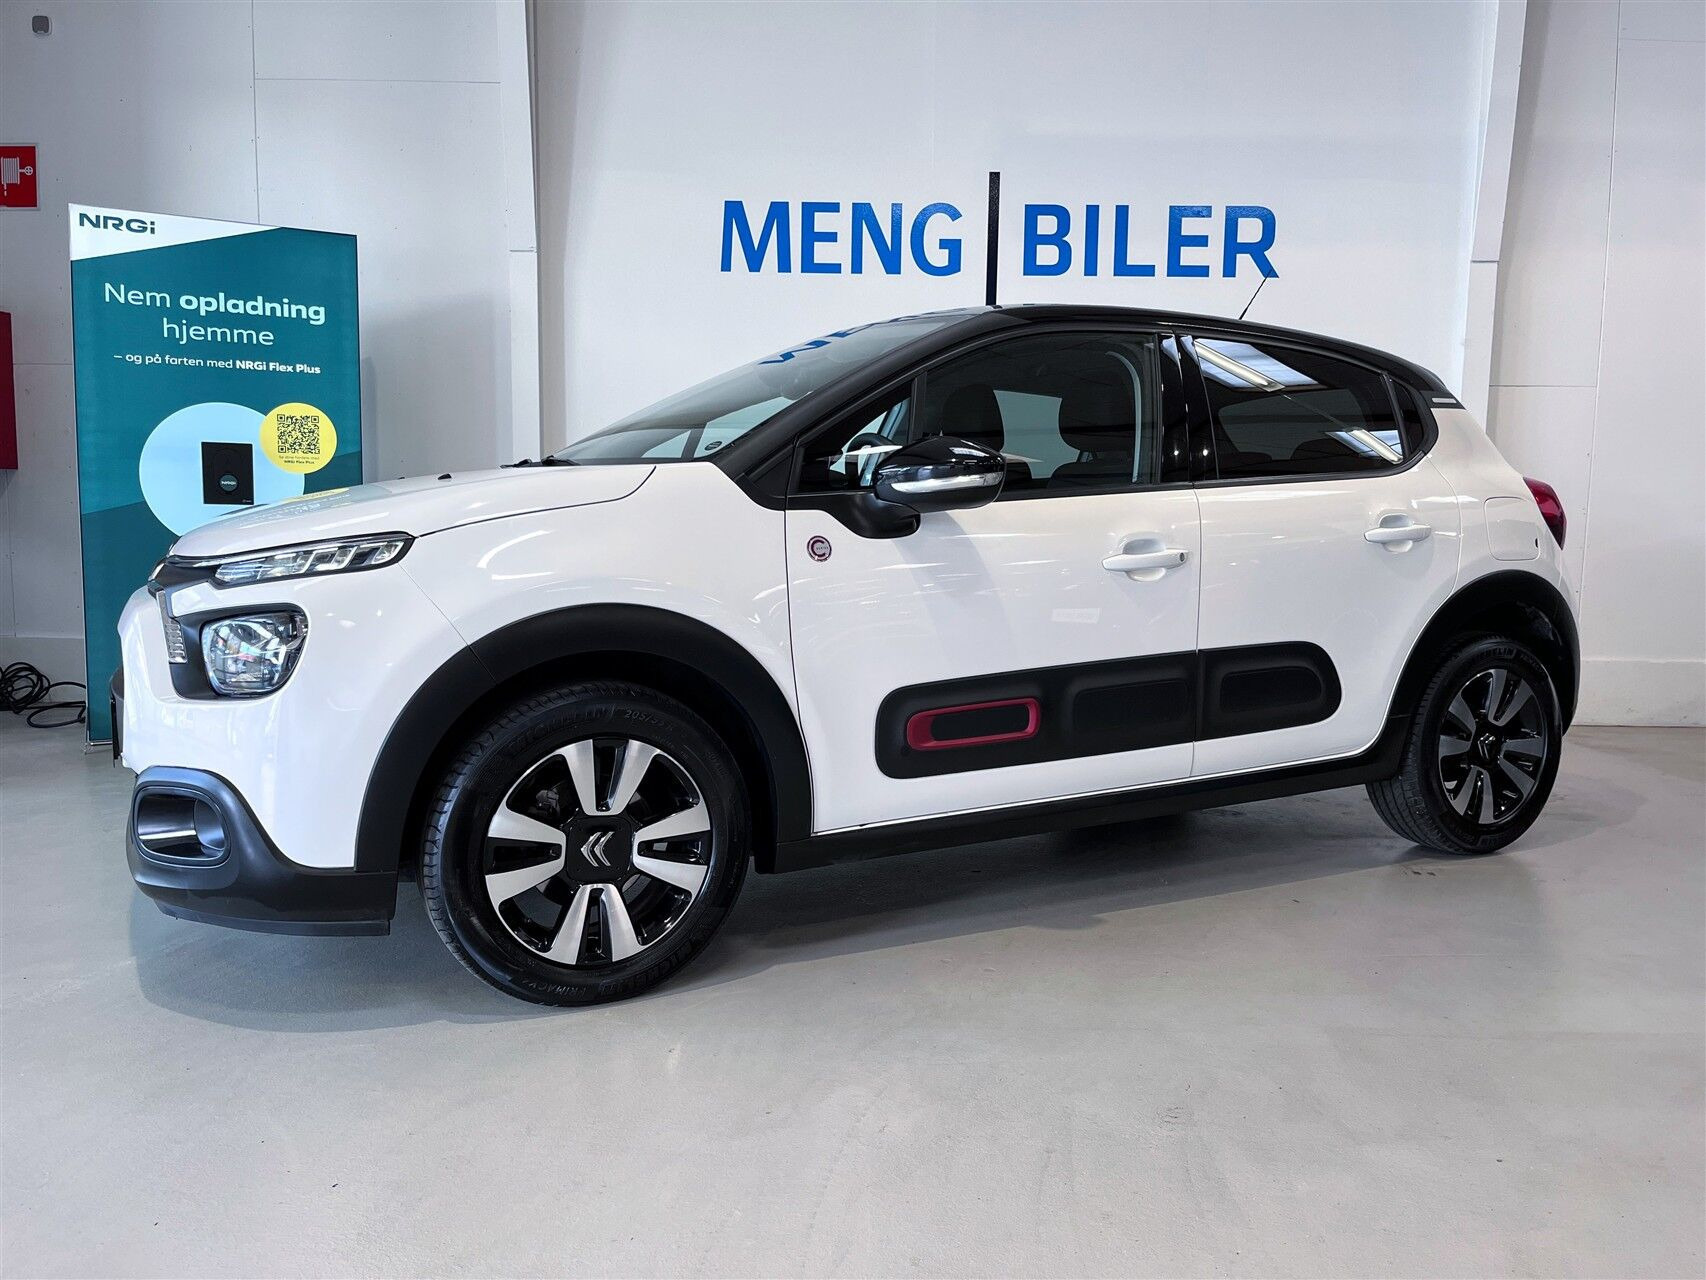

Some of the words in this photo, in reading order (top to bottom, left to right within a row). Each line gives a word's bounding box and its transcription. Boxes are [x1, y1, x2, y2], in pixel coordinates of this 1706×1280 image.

[78, 212, 156, 235] NRGi
[720, 200, 963, 277] MENG
[1022, 203, 1280, 279] BILER
[104, 282, 171, 308] Nem
[179, 292, 326, 326] opladning
[162, 317, 275, 346] hjemme
[125, 354, 143, 365] og
[145, 353, 162, 365] på
[164, 354, 204, 367] farten
[206, 359, 233, 369] med
[235, 359, 267, 372] NRGi
[268, 361, 294, 374] Flex
[295, 363, 321, 375] Plus
